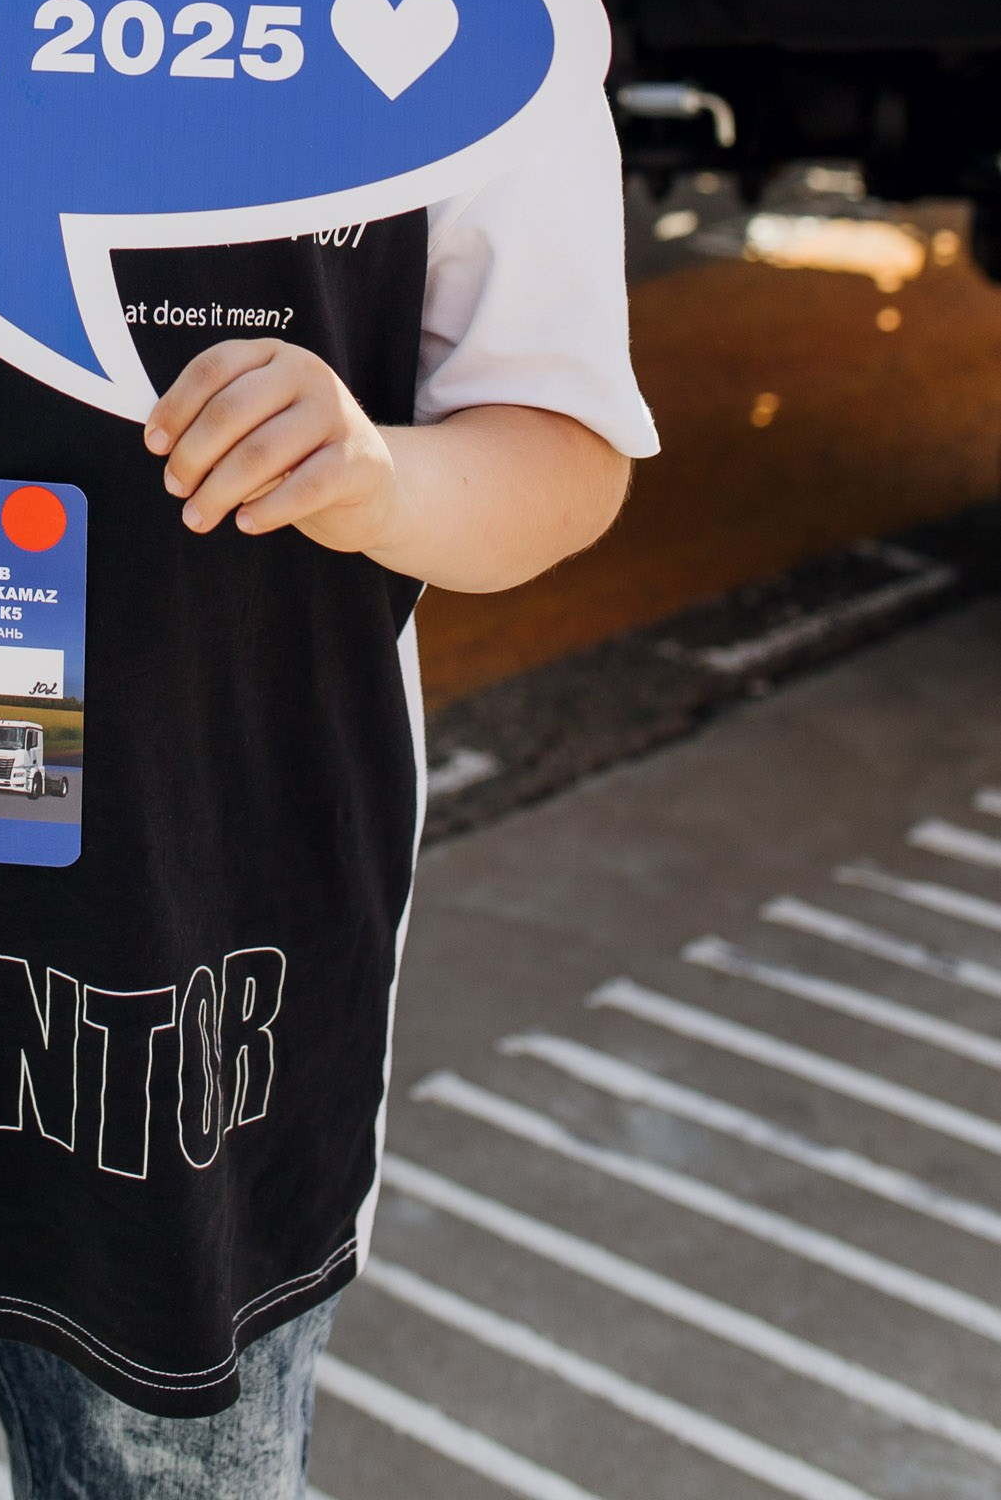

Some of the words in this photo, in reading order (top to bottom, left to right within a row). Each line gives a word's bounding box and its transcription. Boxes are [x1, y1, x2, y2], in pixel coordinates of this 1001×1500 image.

[153, 299, 207, 327] does
[211, 302, 223, 327] it
[226, 307, 294, 330] mean?
